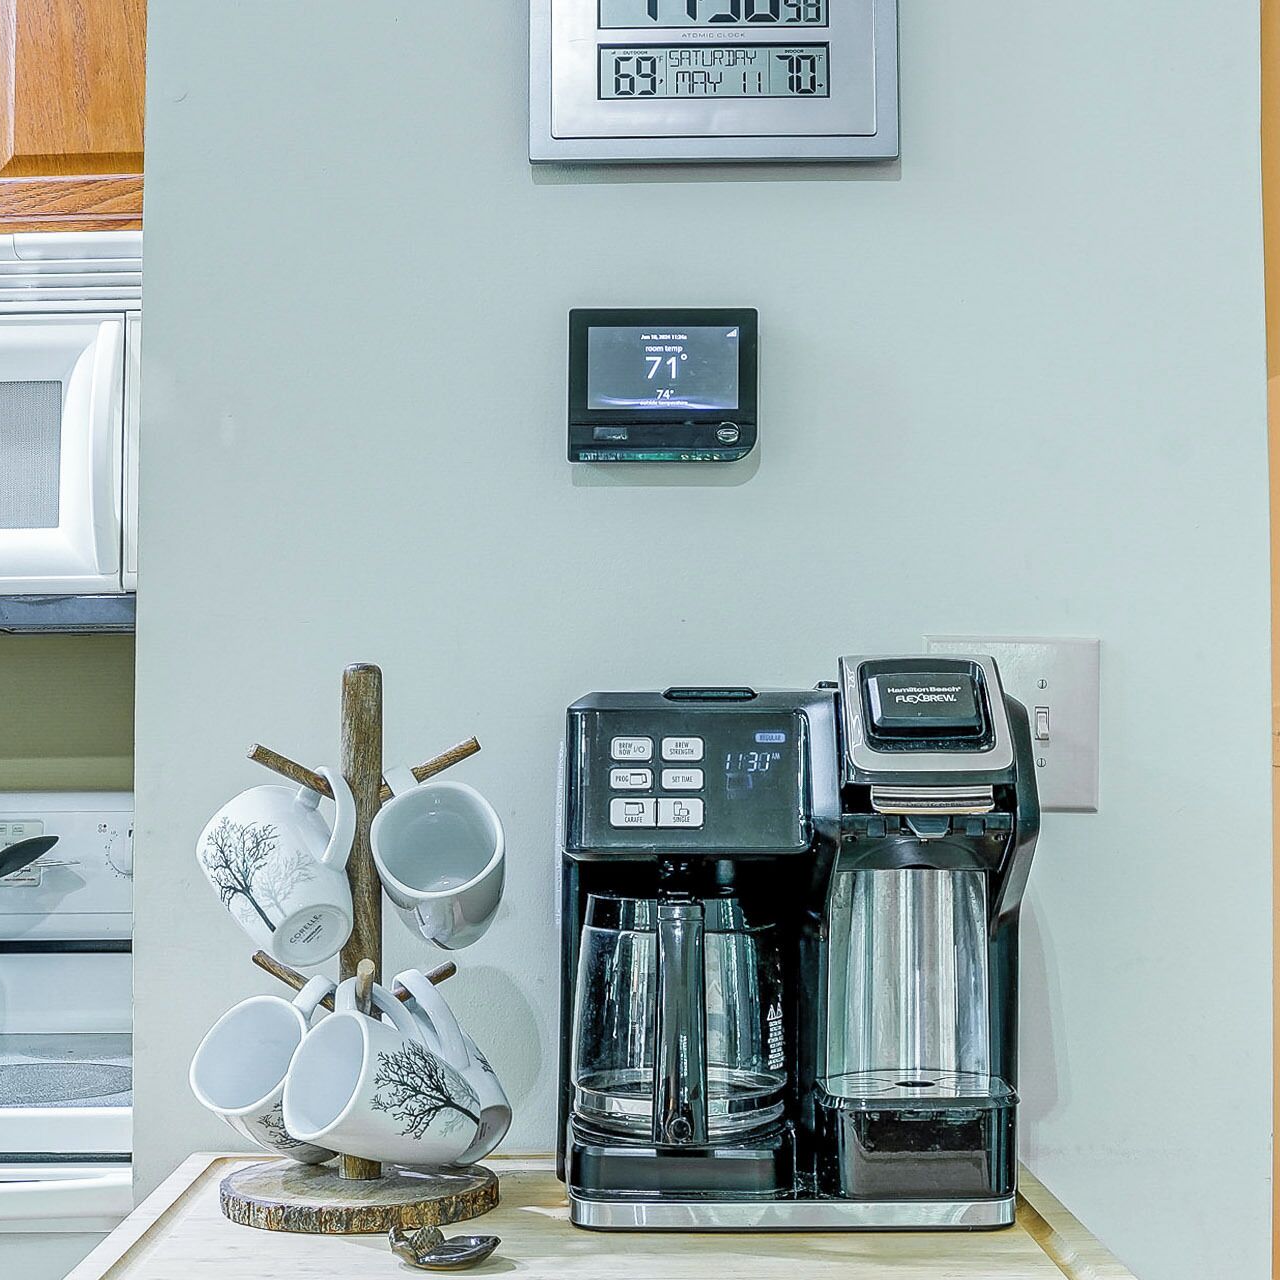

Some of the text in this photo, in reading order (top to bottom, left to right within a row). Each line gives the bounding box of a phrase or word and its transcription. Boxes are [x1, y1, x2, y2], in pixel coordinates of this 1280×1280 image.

[668, 49, 757, 68] SATURDAY
[614, 56, 657, 96] 69
[675, 70, 762, 94] MAY 11
[775, 54, 816, 95] 70
[664, 345, 683, 353] temp
[887, 685, 959, 694] Hamilton Beach
[771, 752, 781, 760] AM
[672, 816, 691, 824] SINGLE
[289, 913, 323, 945] CORELLE
